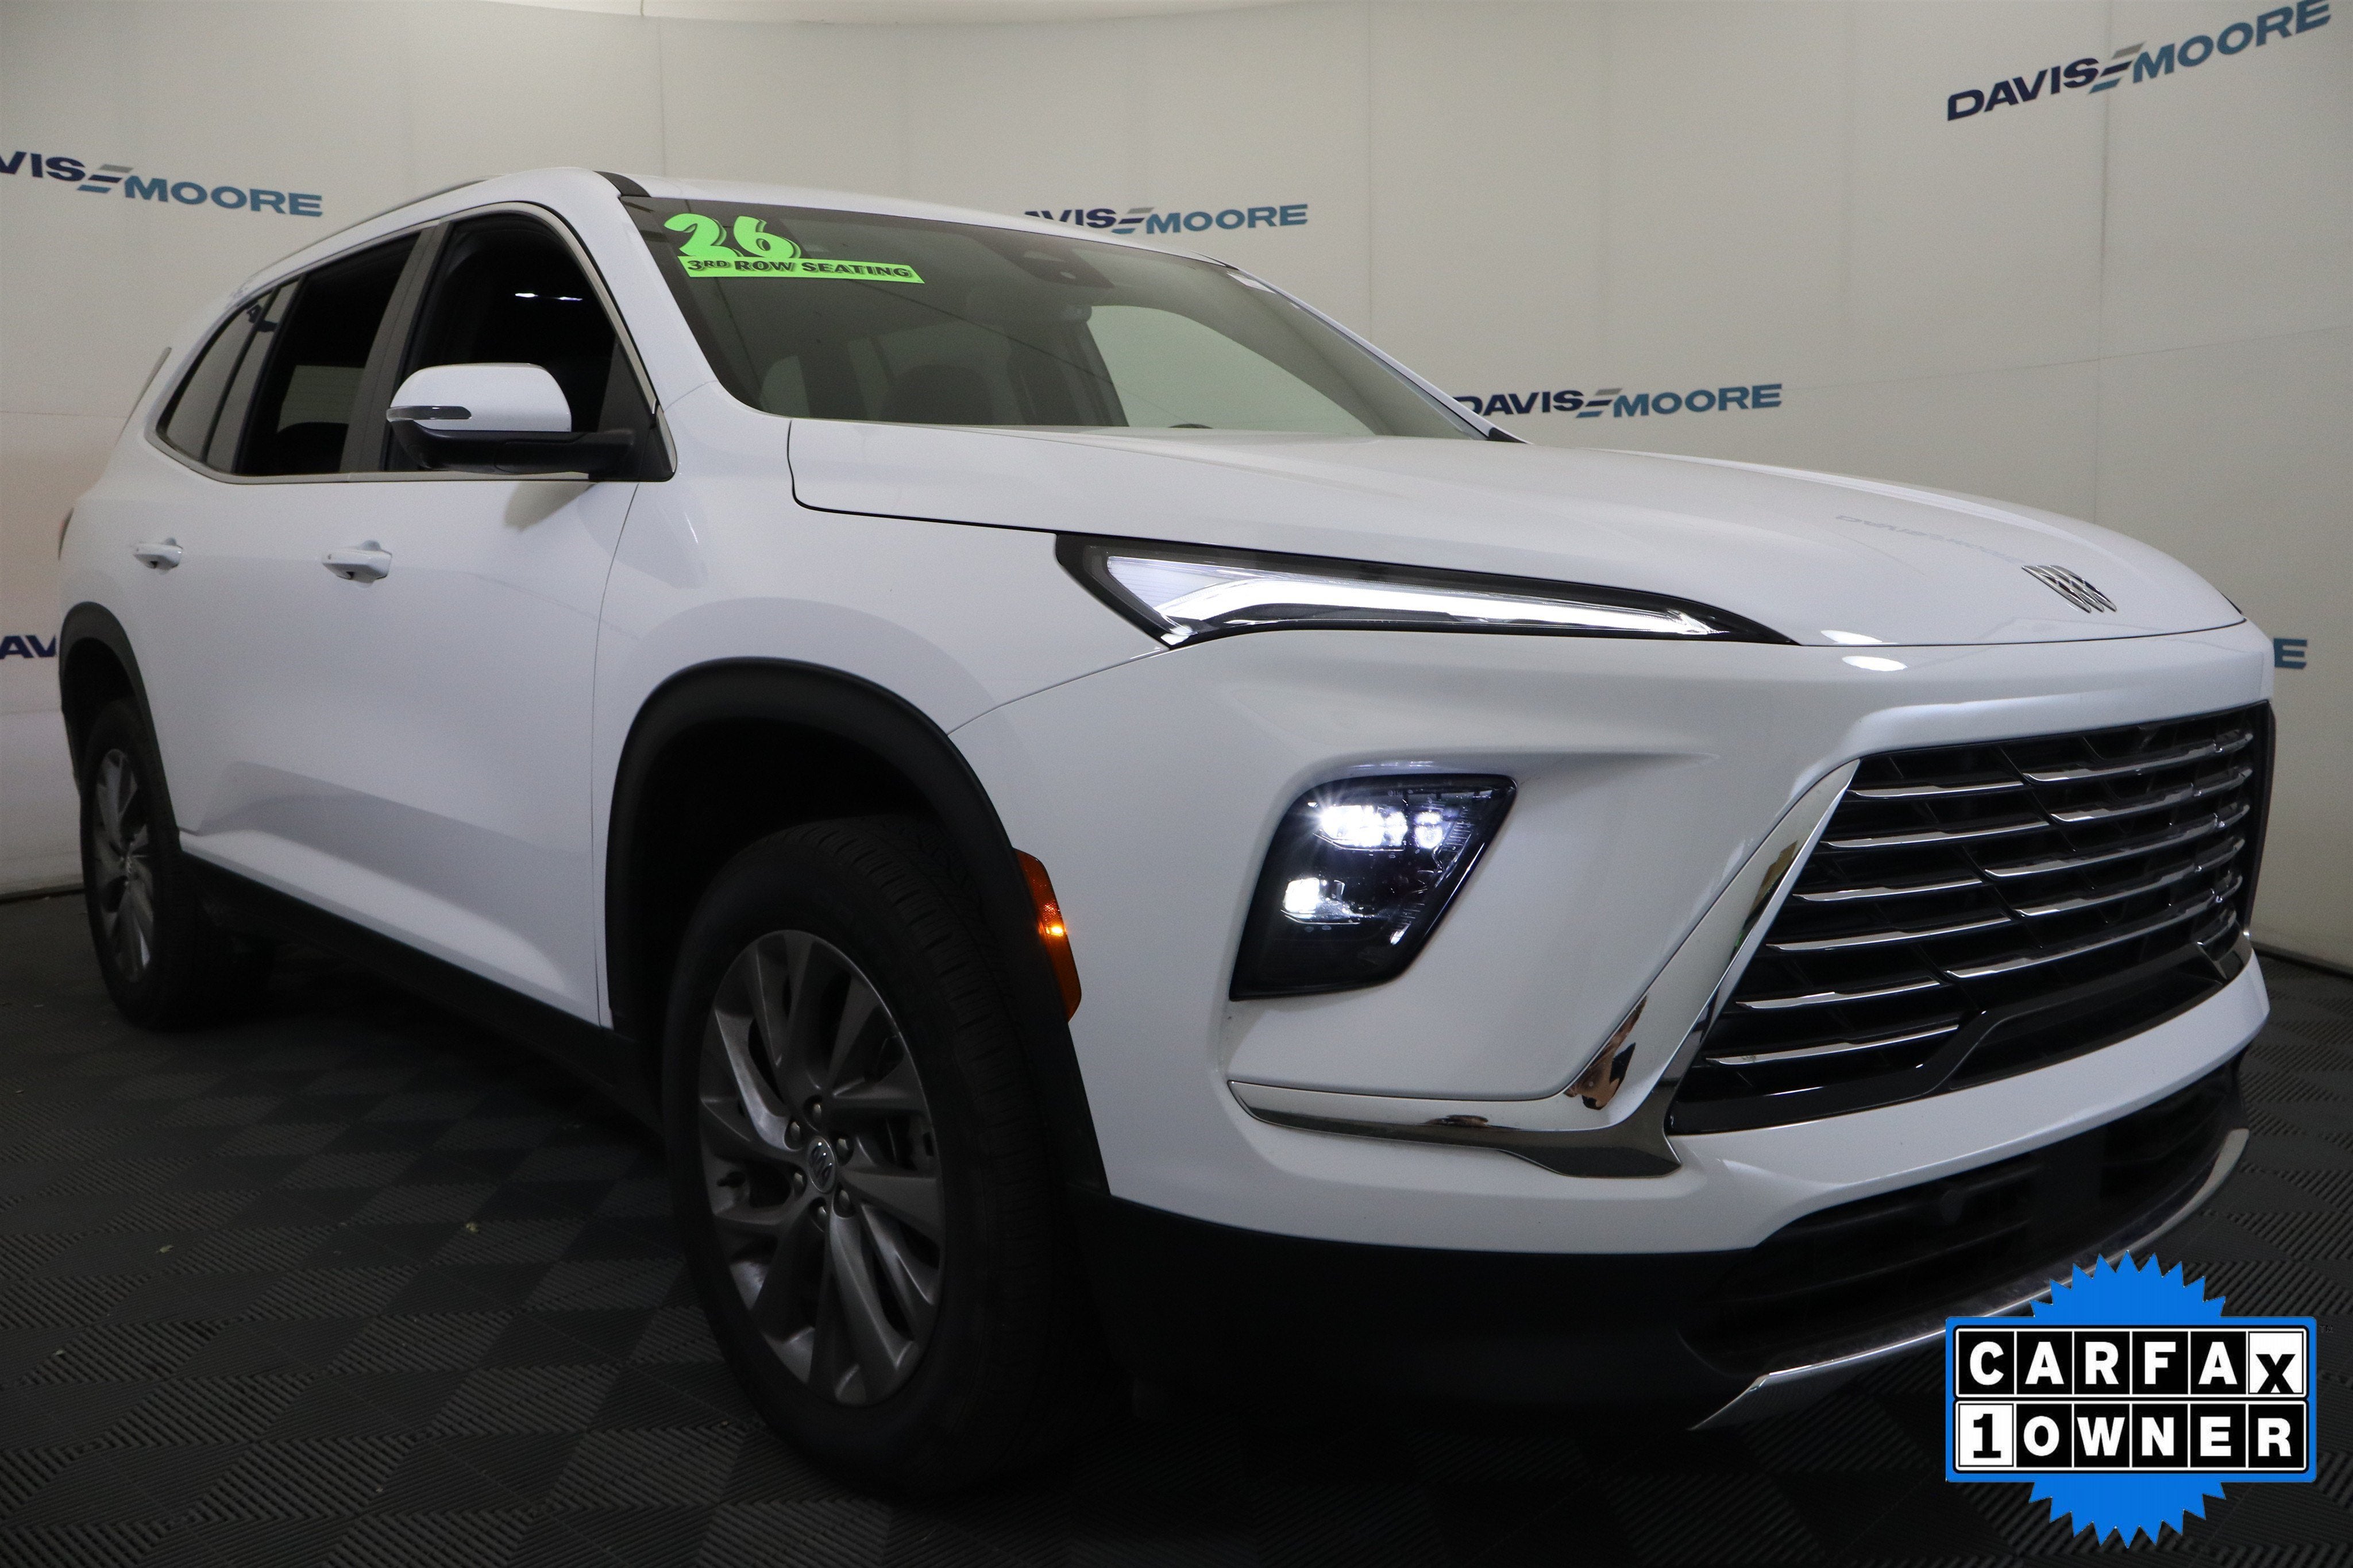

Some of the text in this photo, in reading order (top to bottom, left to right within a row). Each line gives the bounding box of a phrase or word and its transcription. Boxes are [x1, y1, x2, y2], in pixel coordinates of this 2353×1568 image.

[1947, 0, 2331, 122] DAVIS MOORE
[124, 175, 323, 217] MOORE
[664, 213, 802, 258] 26
[1145, 203, 1308, 234] MOORE
[687, 260, 912, 277] 3RD ROW SEATING
[1613, 383, 1783, 419] MOORE
